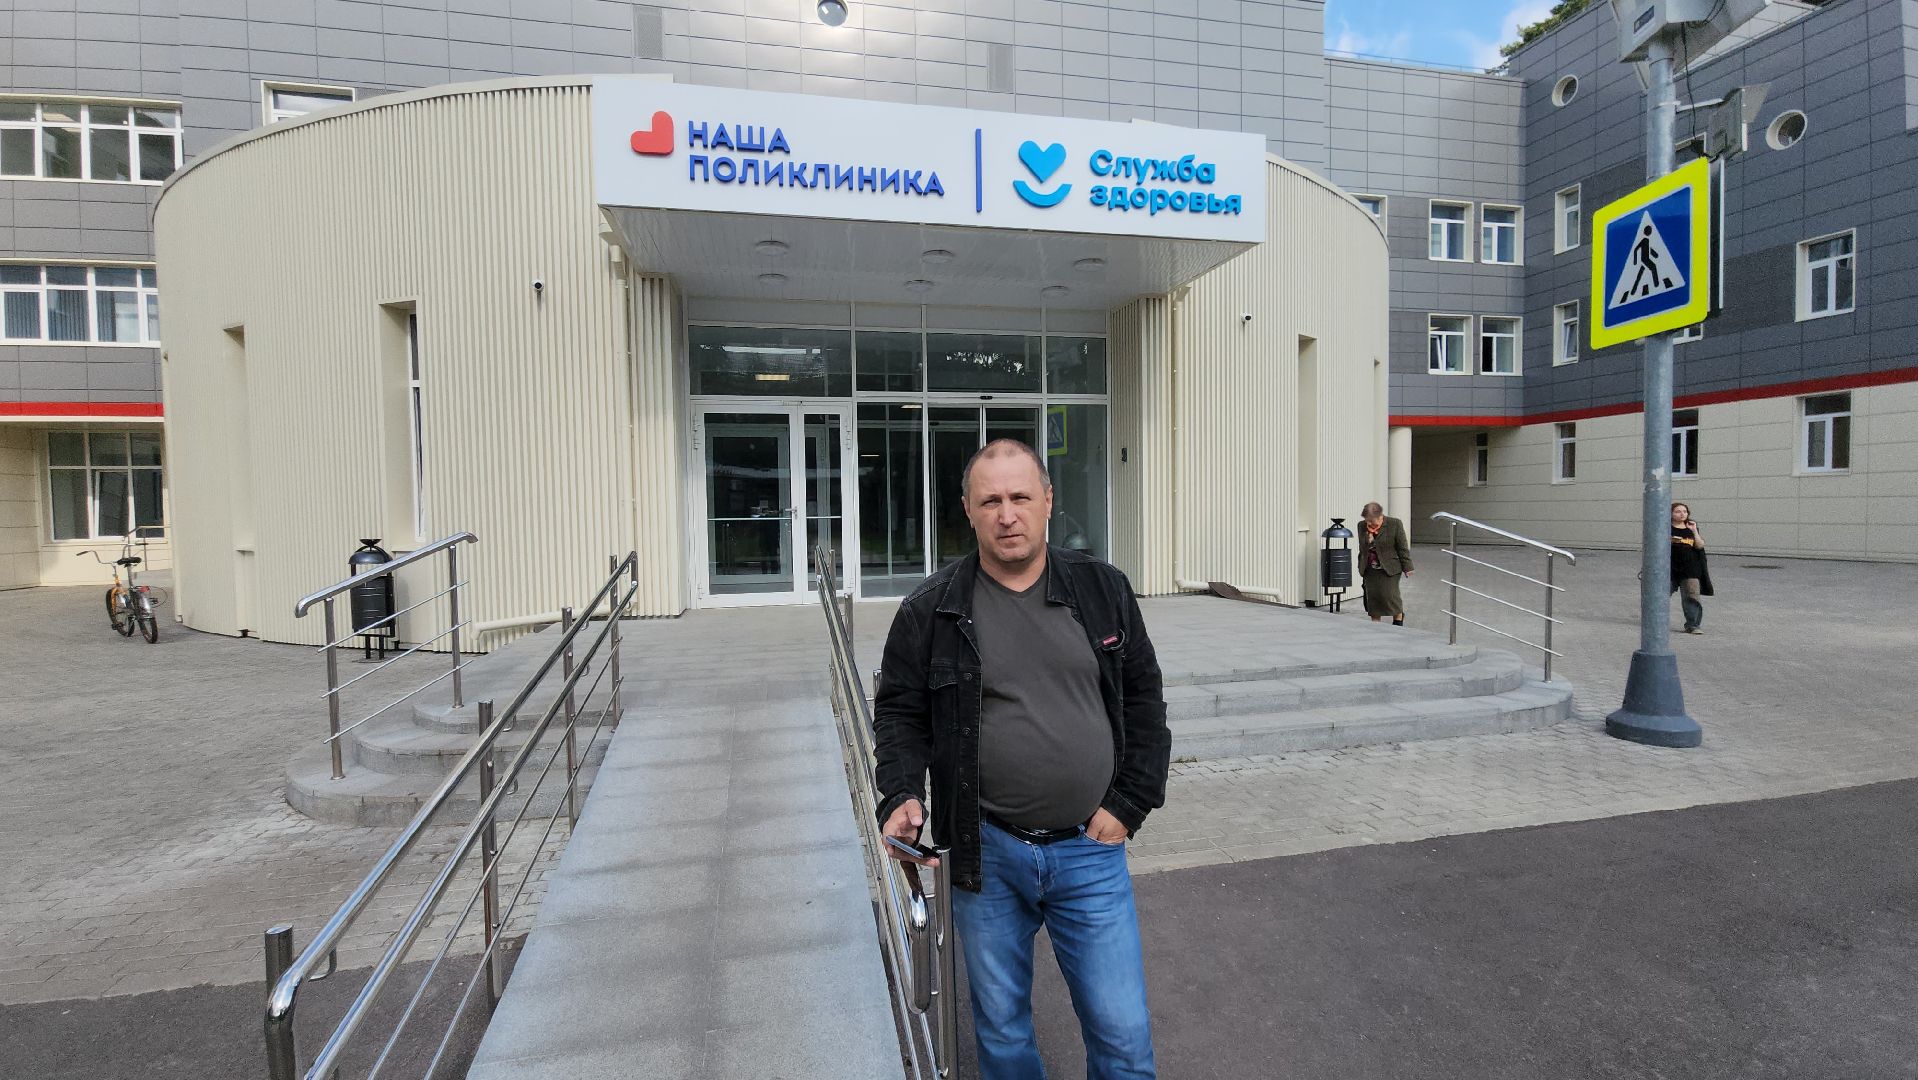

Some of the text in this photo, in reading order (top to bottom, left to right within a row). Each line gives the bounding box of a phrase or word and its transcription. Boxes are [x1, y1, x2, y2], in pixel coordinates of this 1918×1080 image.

[688, 120, 790, 153] НАША
[689, 154, 945, 196] ПОЛИКЛИНИКА
[1089, 149, 1216, 185] Служба
[1089, 185, 1242, 216] здоровья
